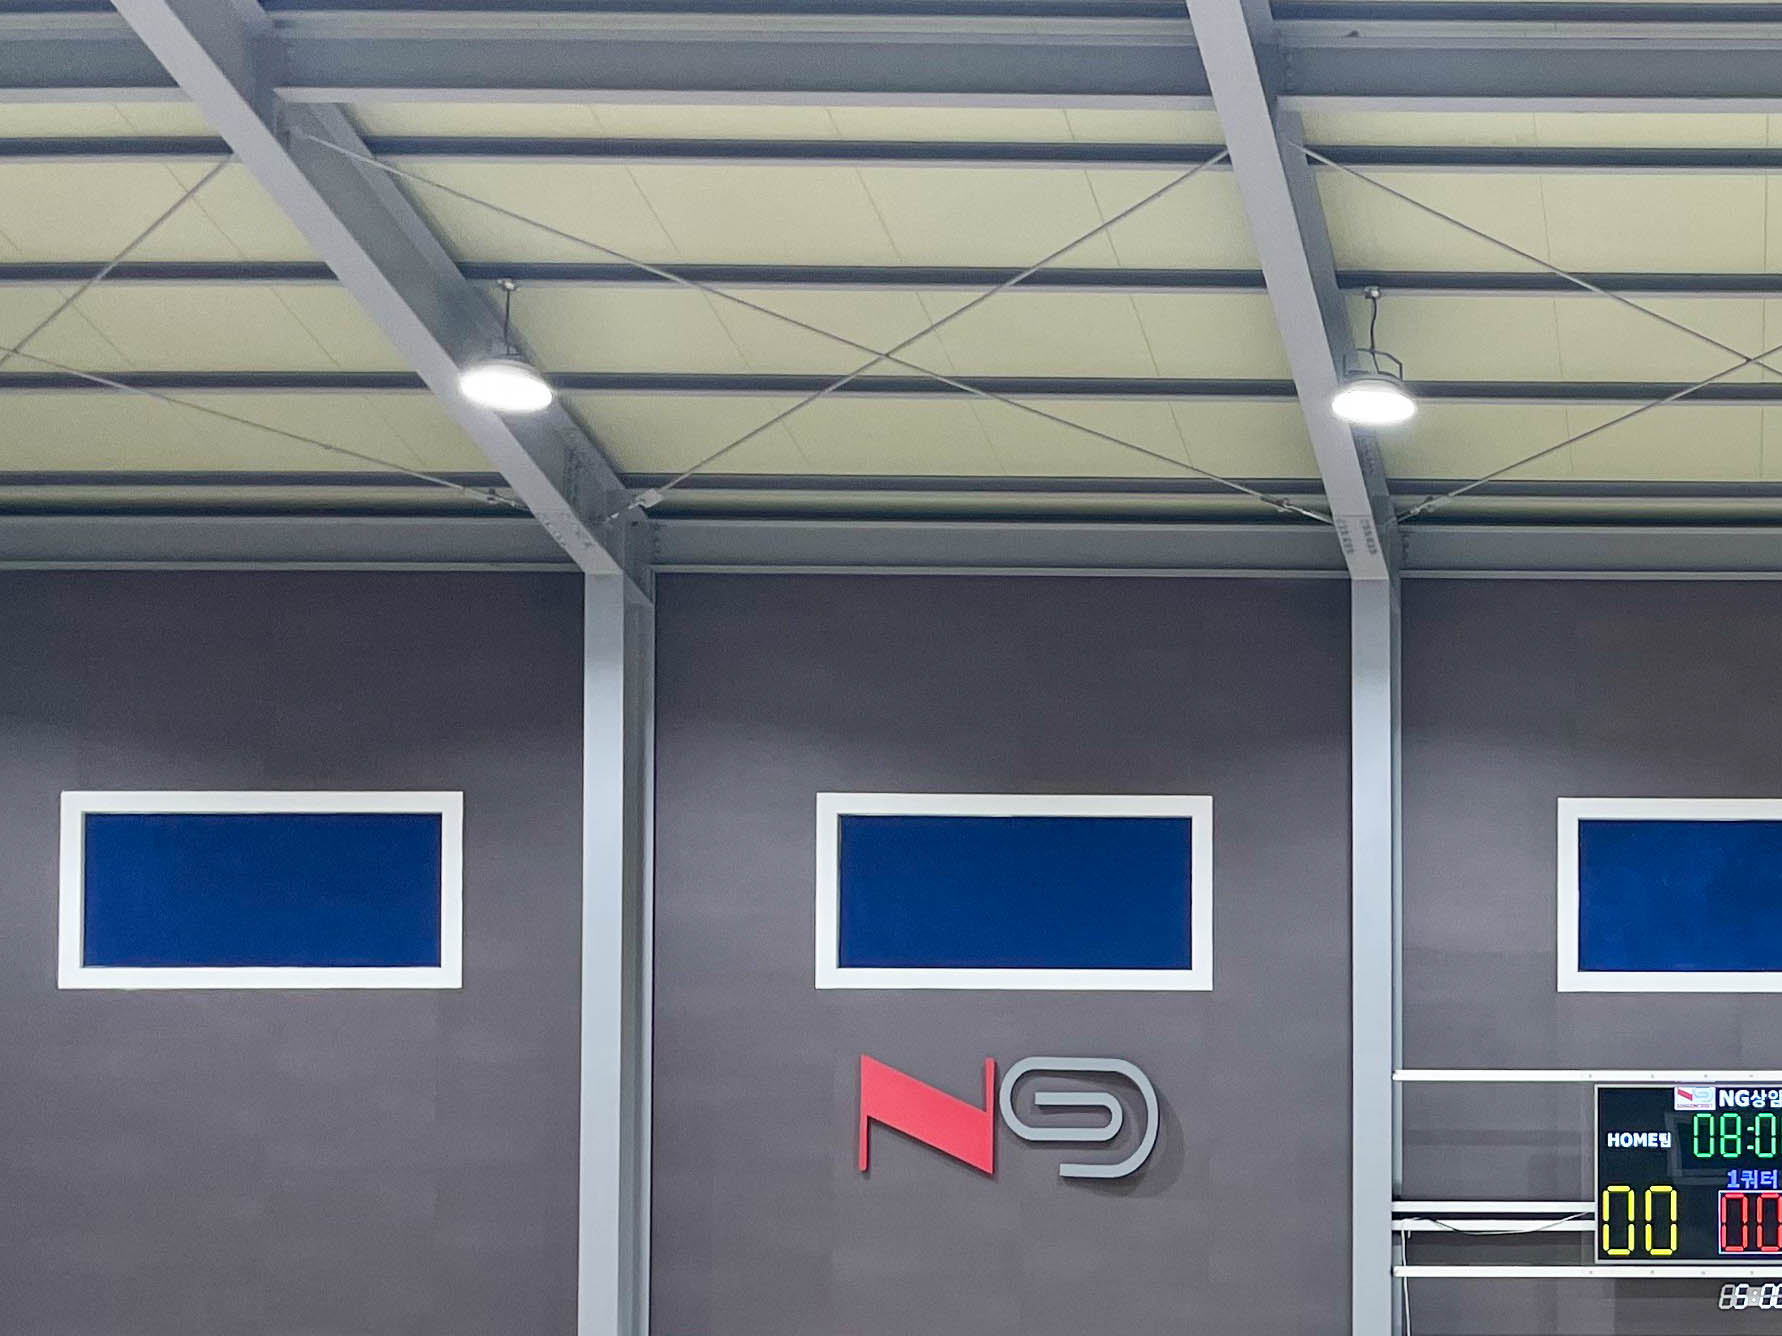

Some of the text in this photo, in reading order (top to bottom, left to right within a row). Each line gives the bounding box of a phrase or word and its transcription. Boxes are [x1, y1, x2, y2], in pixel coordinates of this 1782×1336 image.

[1607, 1132, 1671, 1148] HOME팀
[1727, 1169, 1778, 1189] 1쿼터
[1602, 1185, 1678, 1255] 00
